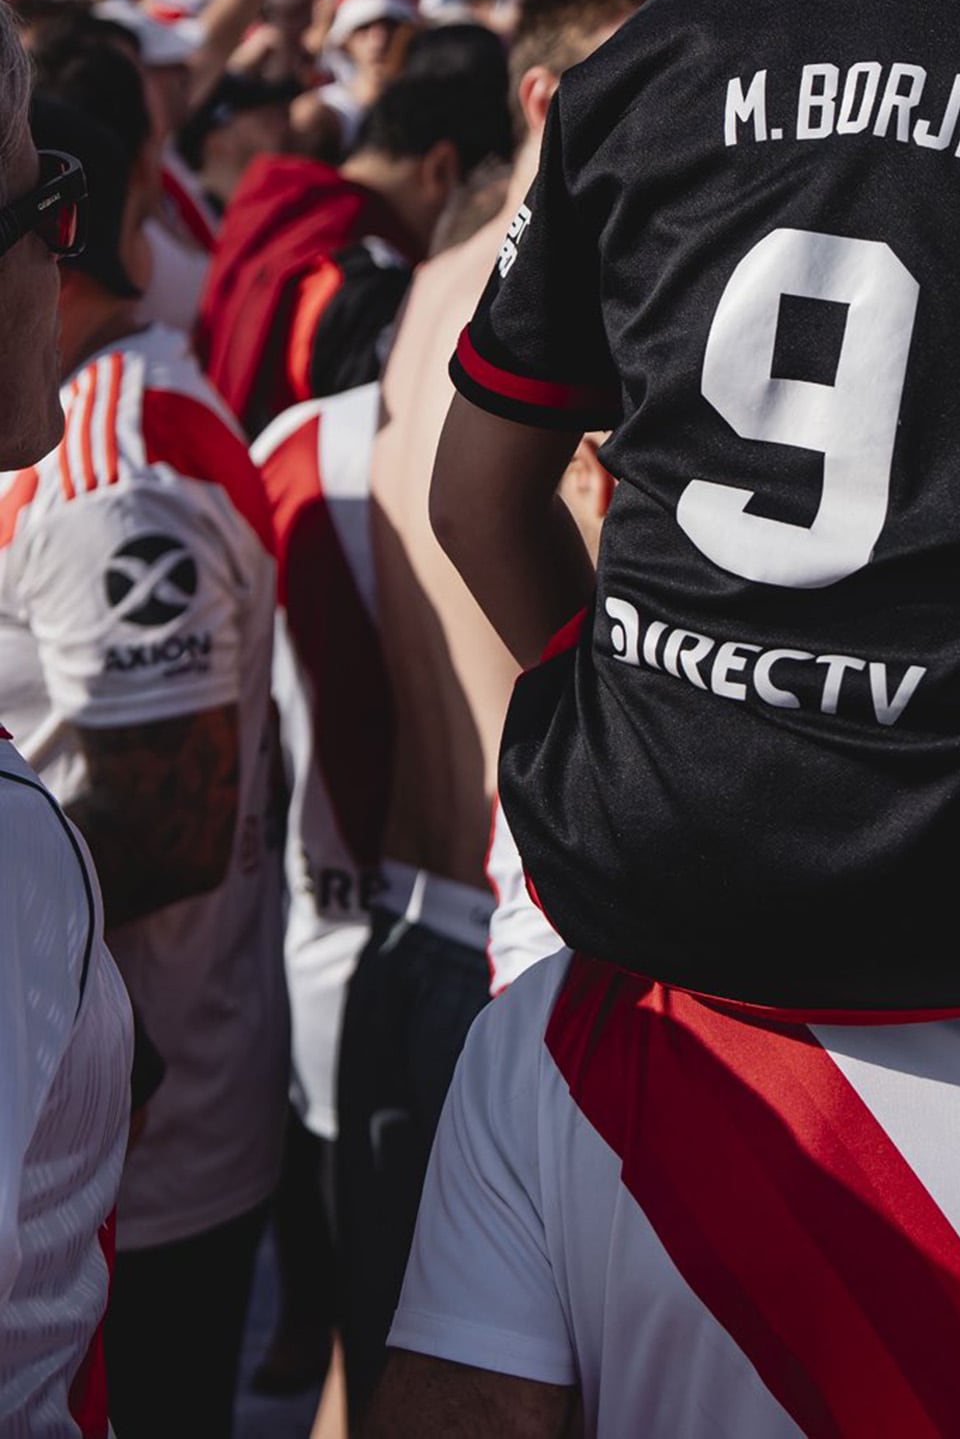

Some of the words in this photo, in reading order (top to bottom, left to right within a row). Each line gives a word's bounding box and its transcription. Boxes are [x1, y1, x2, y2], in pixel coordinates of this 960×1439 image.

[675, 227, 921, 589] 9
[104, 630, 212, 673] AXION
[604, 595, 928, 727] DIRECTV
